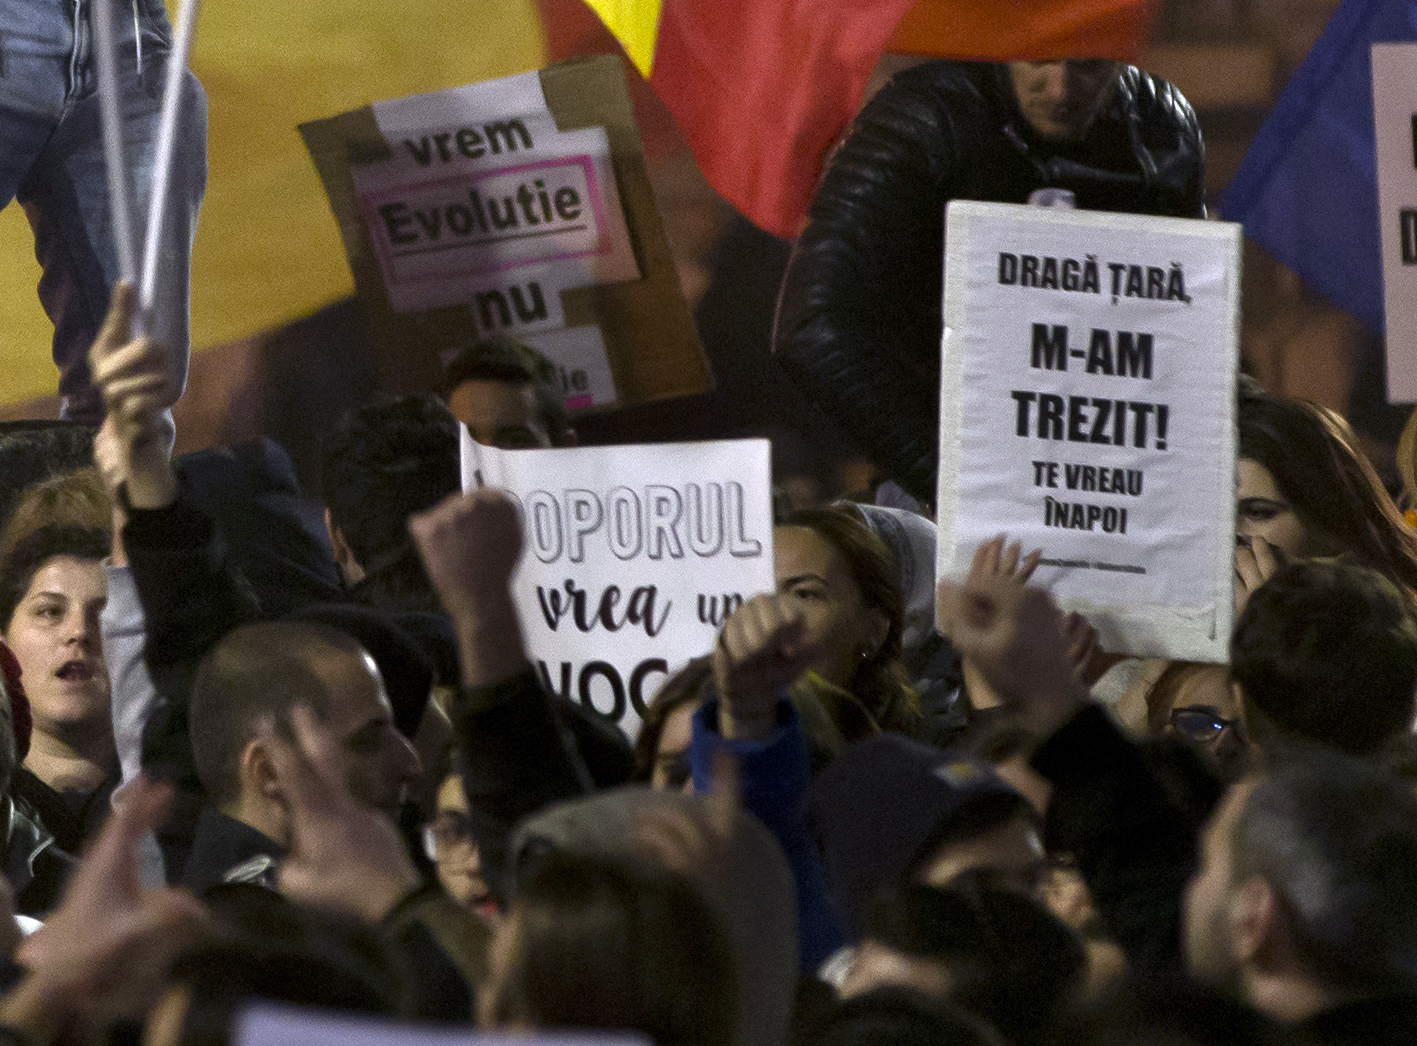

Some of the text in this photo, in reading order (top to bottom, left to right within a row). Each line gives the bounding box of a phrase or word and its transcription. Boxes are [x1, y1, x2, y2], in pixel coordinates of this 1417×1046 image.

[403, 117, 535, 168] vrem
[382, 179, 584, 246] Evolutie
[996, 251, 1102, 296] DRAGĂ
[473, 281, 549, 331] nu
[1029, 321, 1155, 381] M-AM
[1010, 389, 1170, 451] TREZIT!
[1032, 460, 1144, 497] TE VREAU
[504, 481, 763, 565] OPORUL
[1043, 495, 1128, 534] ÎNAPOI
[536, 578, 673, 638] vrea
